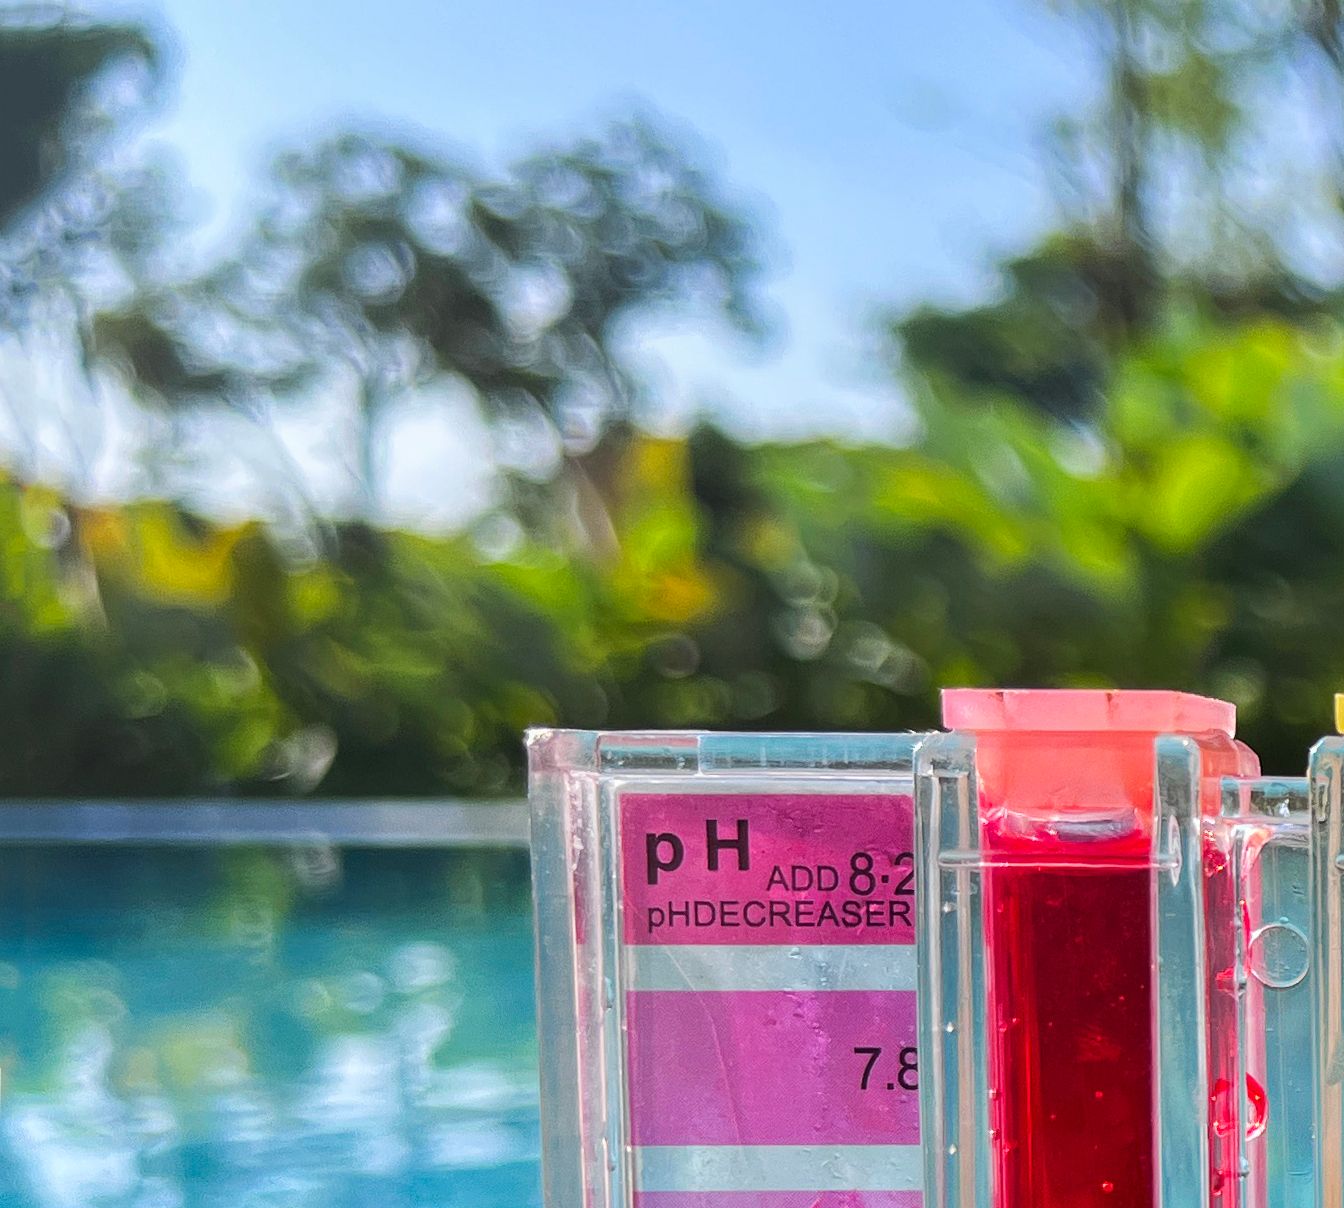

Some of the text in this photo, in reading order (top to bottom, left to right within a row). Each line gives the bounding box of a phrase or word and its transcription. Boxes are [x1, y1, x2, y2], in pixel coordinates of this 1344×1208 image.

[766, 865, 839, 892] ADD
[647, 900, 912, 933] pHDECREASER
[853, 1046, 919, 1090] 7.8
